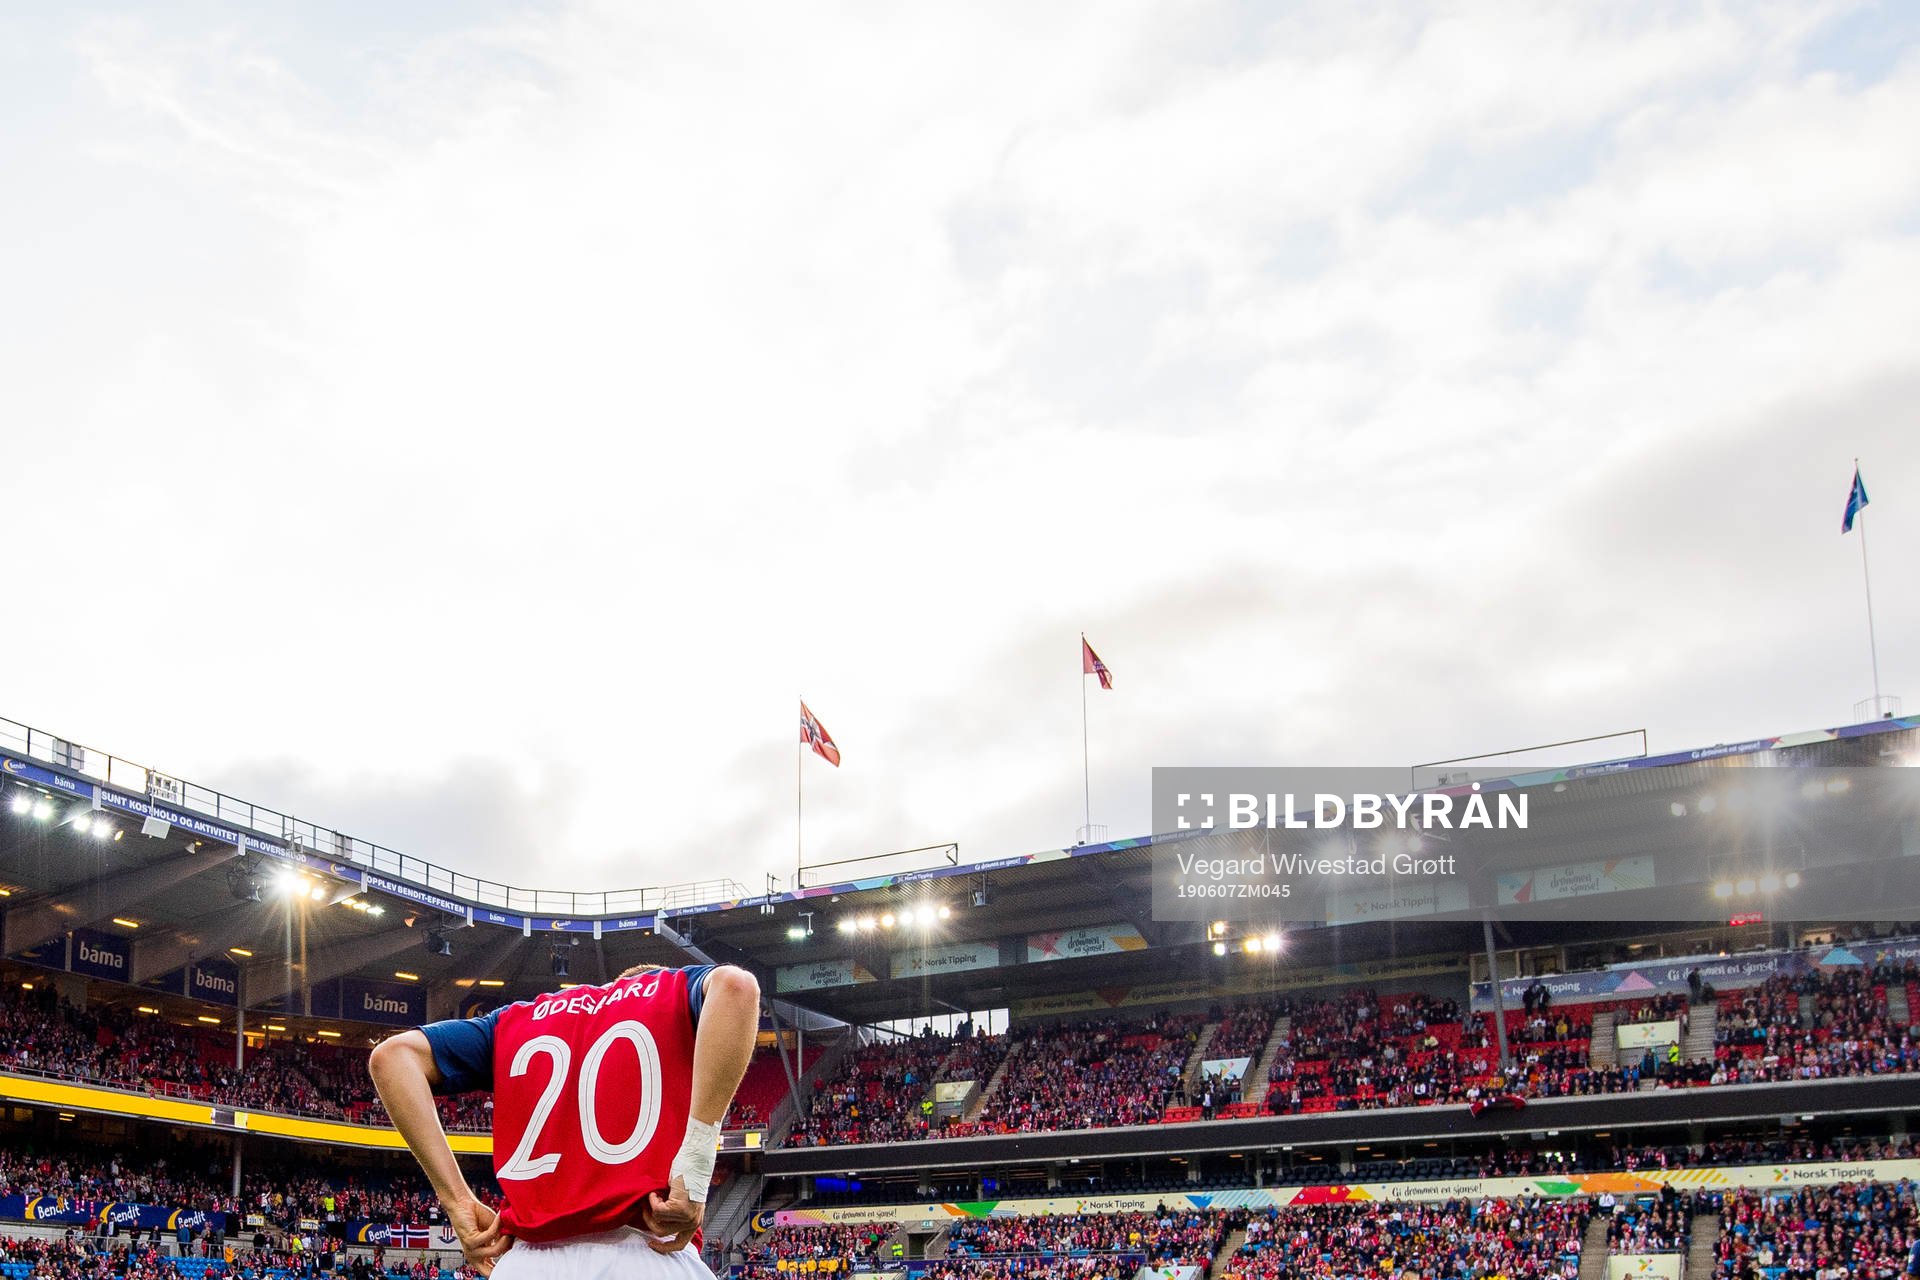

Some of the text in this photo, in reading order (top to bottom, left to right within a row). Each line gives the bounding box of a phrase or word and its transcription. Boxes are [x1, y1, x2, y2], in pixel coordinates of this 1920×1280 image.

[54, 776, 76, 791] bama
[101, 790, 238, 841] SUNT KOSTHOLD OG AKTIVITET
[245, 836, 260, 849] GIR
[366, 875, 465, 914] OPPLEV BENDIT-EFFEKTEN
[1370, 895, 1440, 912] Norsk Tipping
[489, 912, 506, 923] bama
[618, 920, 638, 929] bama
[79, 942, 123, 969] bama
[925, 953, 977, 966] Norsk Tipping
[196, 968, 235, 994] bama
[1544, 981, 1581, 994] Tipping
[363, 995, 408, 1015] bama
[496, 1019, 662, 1181] 20
[1793, 1166, 1875, 1179] Norsk Tipping
[1089, 1199, 1145, 1209] Norsk Tipping
